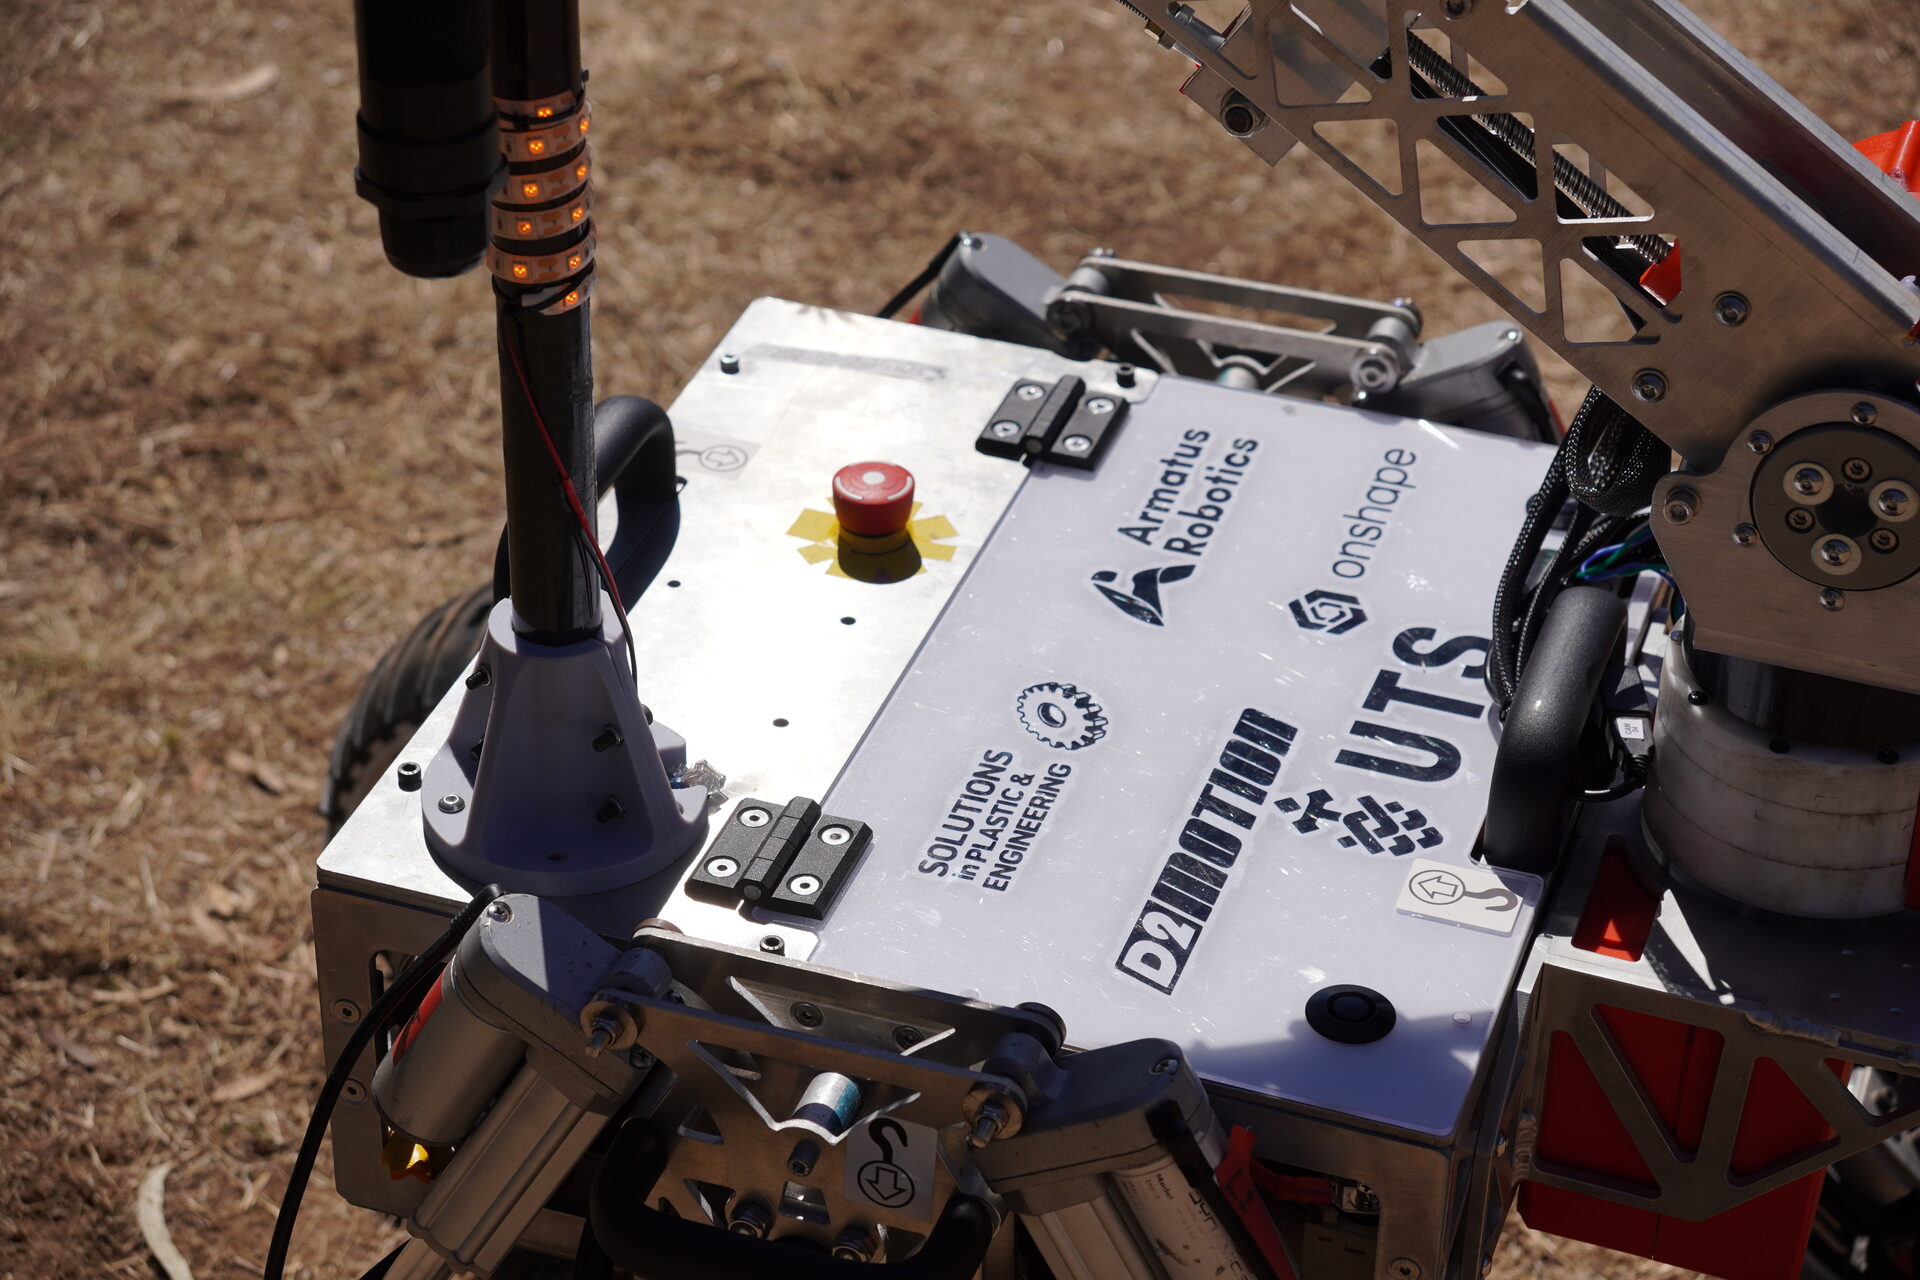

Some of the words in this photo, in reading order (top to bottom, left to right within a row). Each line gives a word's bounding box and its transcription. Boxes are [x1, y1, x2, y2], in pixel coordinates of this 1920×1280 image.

[1118, 428, 1211, 546] Armatus
[1163, 437, 1259, 556] Robotics
[1332, 447, 1417, 579] onshape
[1335, 627, 1492, 783] UTS
[917, 749, 1014, 878] SOLUTIONS
[964, 787, 1025, 864] PLASTIC
[982, 762, 1072, 892] ENGINEERING
[1009, 773, 1036, 787] &
[951, 863, 981, 881] in
